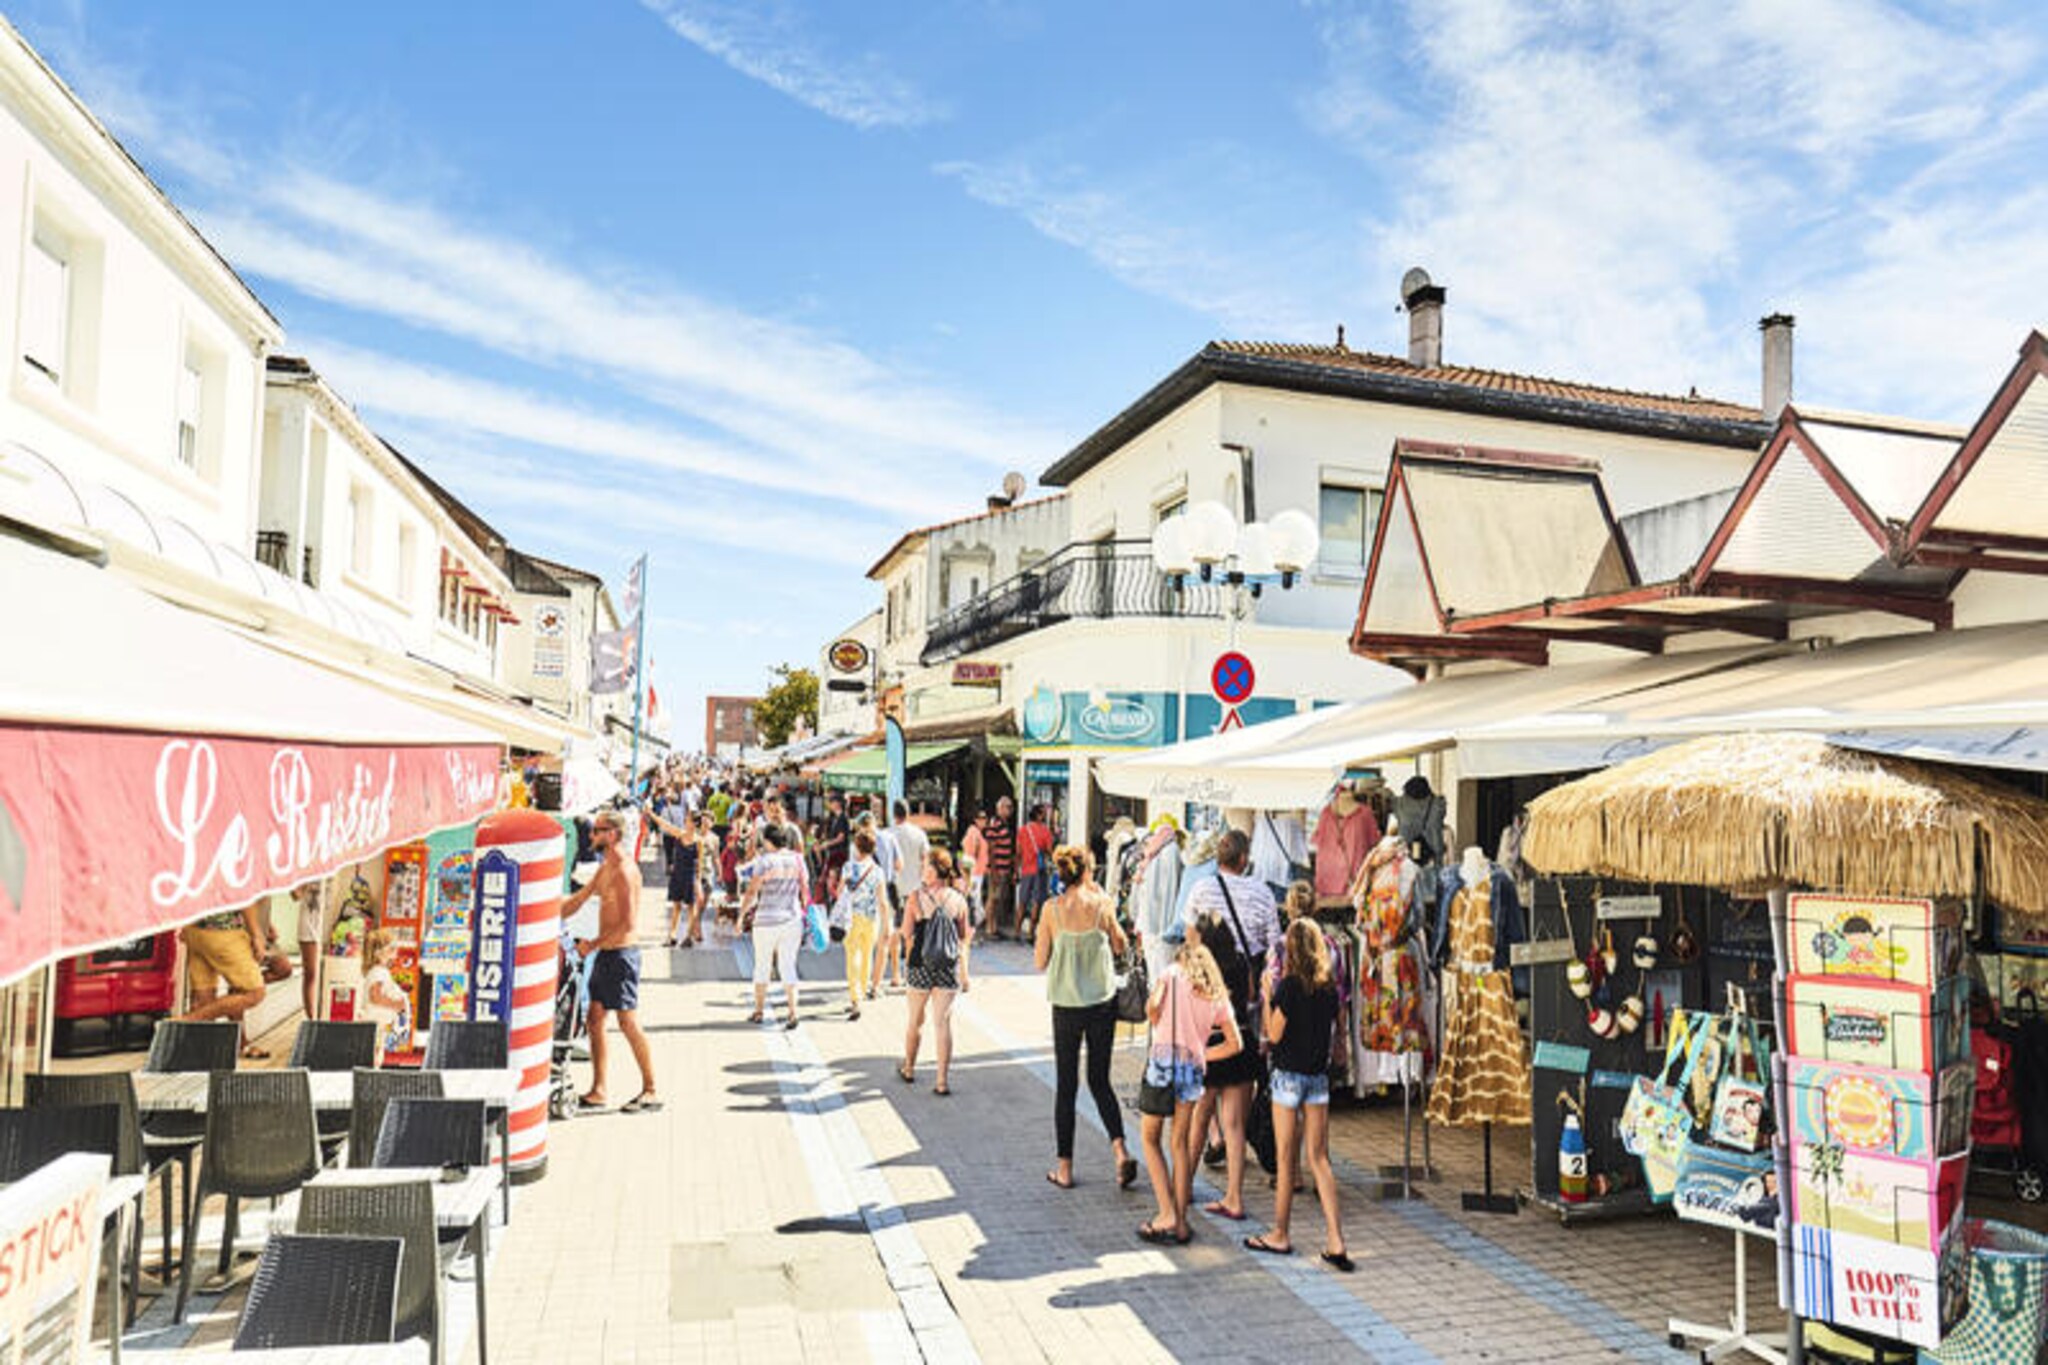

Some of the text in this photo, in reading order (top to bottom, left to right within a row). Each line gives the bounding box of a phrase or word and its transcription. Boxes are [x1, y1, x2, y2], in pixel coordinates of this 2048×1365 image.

[151, 739, 253, 905] Le
[1571, 1156, 1583, 1175] 2
[1845, 1268, 1920, 1299] 100%
[1850, 1296, 1922, 1323] UTILE
